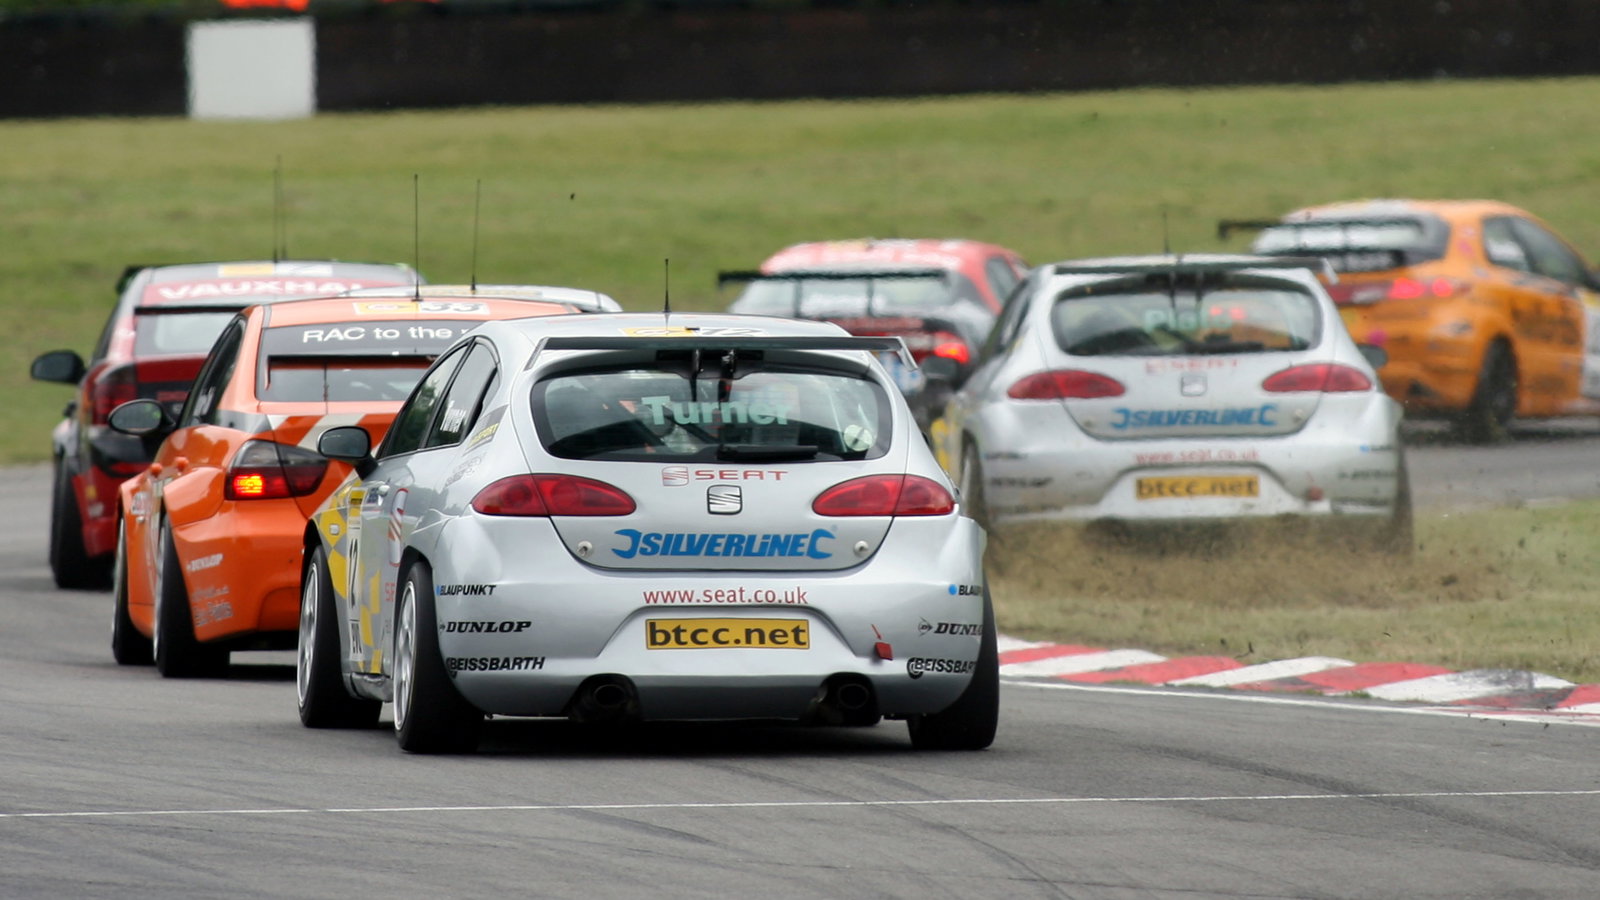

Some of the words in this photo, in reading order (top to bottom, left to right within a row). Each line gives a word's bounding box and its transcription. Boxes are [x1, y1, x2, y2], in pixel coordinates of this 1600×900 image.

[302, 326, 366, 343] RAC
[373, 328, 400, 339] to
[408, 326, 452, 339] the
[642, 396, 790, 426] Turner
[695, 470, 788, 480] SEAT
[1138, 479, 1258, 497] btcc.net
[440, 585, 496, 596] BLAUPUNKT
[643, 587, 808, 604] www.seat.co.uk
[446, 621, 532, 633] DUNLOP
[649, 622, 807, 646] btcc.net
[448, 657, 545, 671] BEISSBARTH
